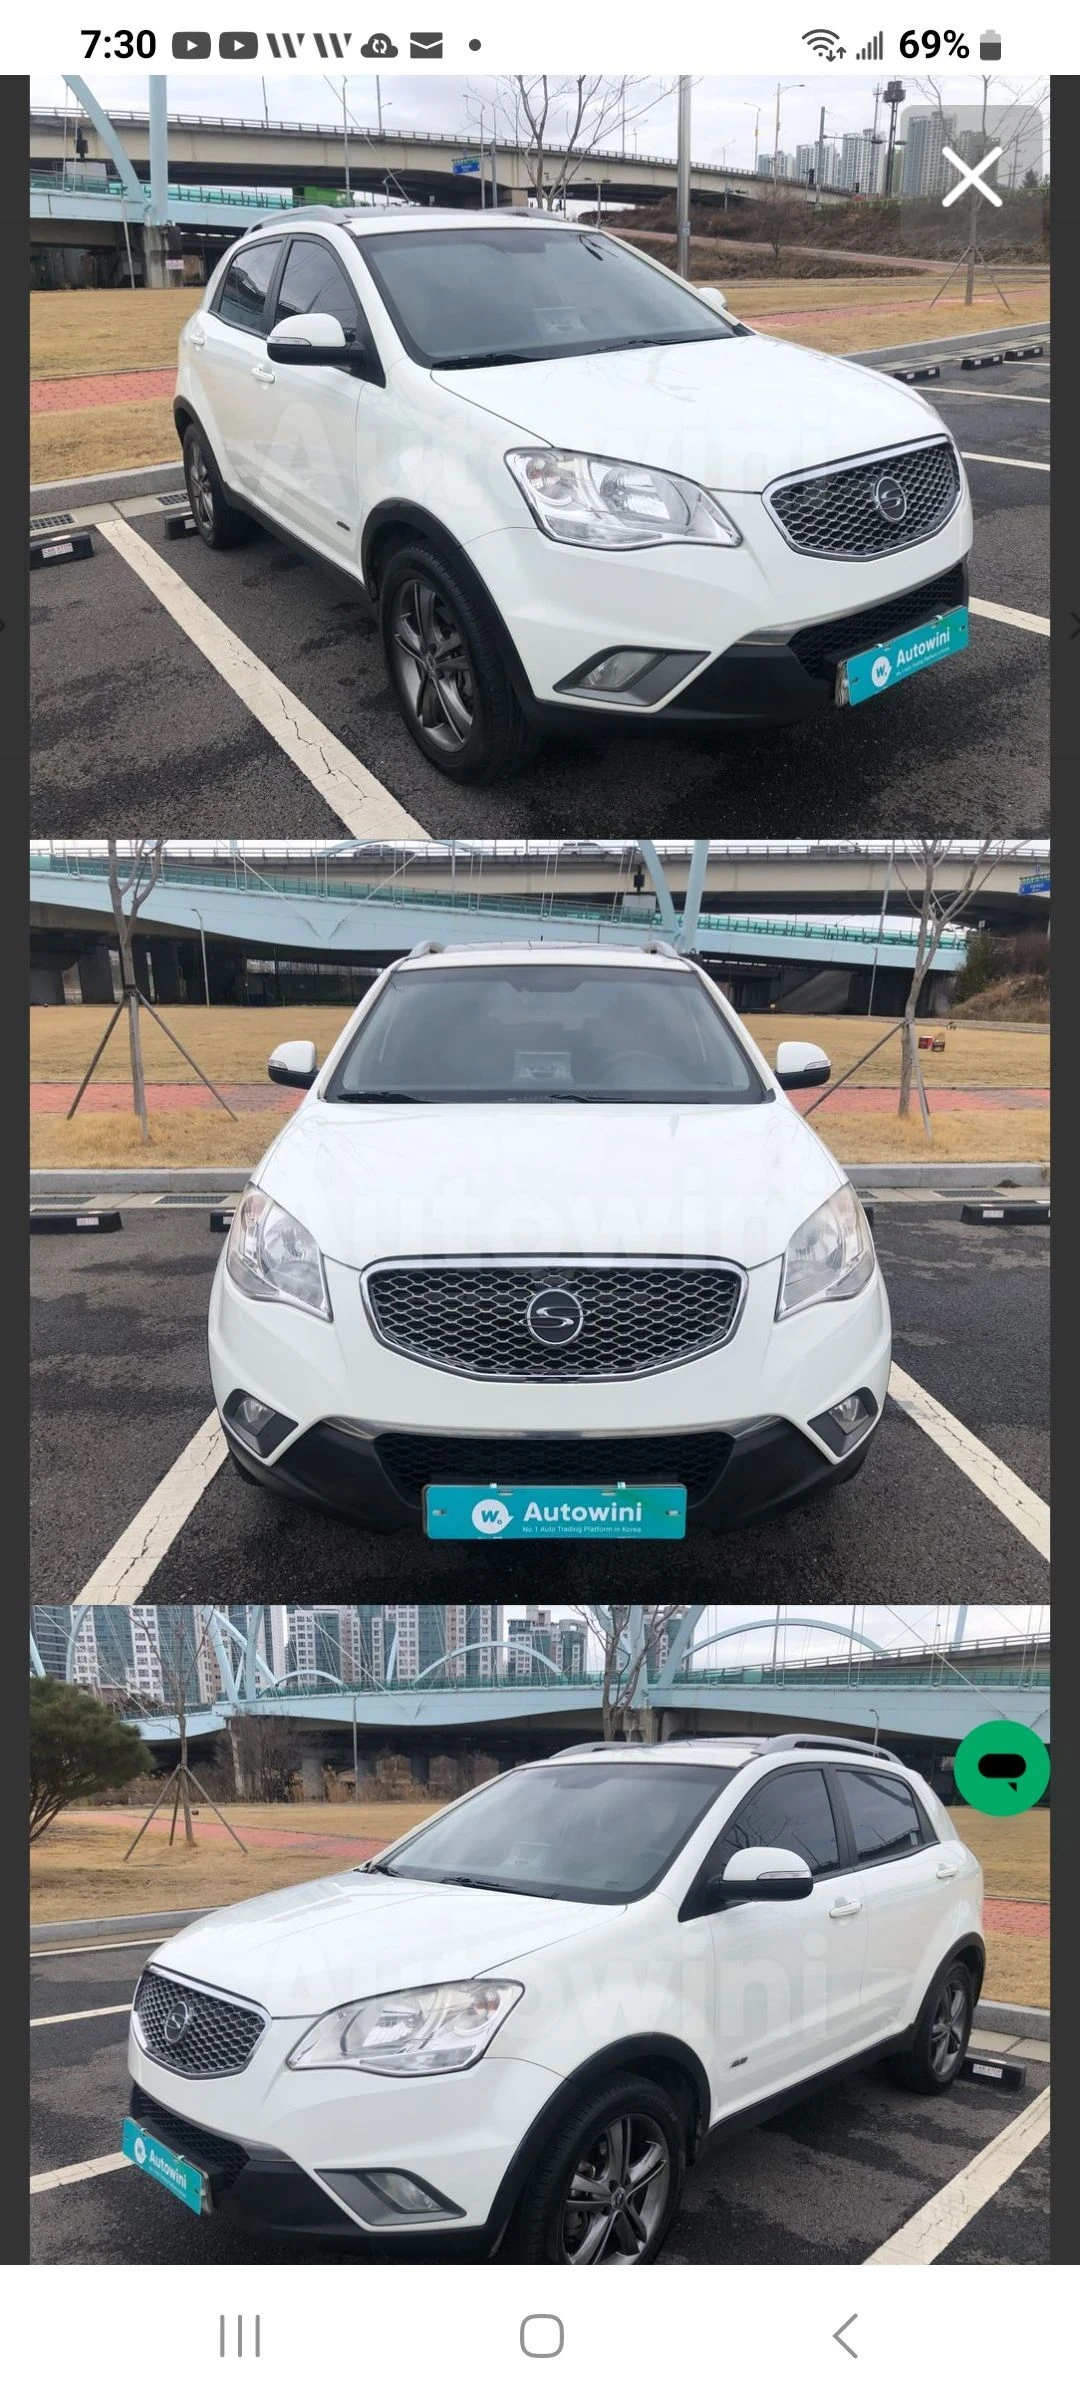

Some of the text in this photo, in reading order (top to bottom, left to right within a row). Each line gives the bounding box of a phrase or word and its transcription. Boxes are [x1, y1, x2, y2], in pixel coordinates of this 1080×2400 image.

[80, 29, 157, 59] 7:30
[899, 29, 970, 59] 69%
[896, 627, 950, 668] Autowini
[523, 1501, 642, 1522] Autowini
[558, 1525, 583, 1534] Trading
[583, 1525, 613, 1533] Platform
[149, 2149, 187, 2190] Autowini
